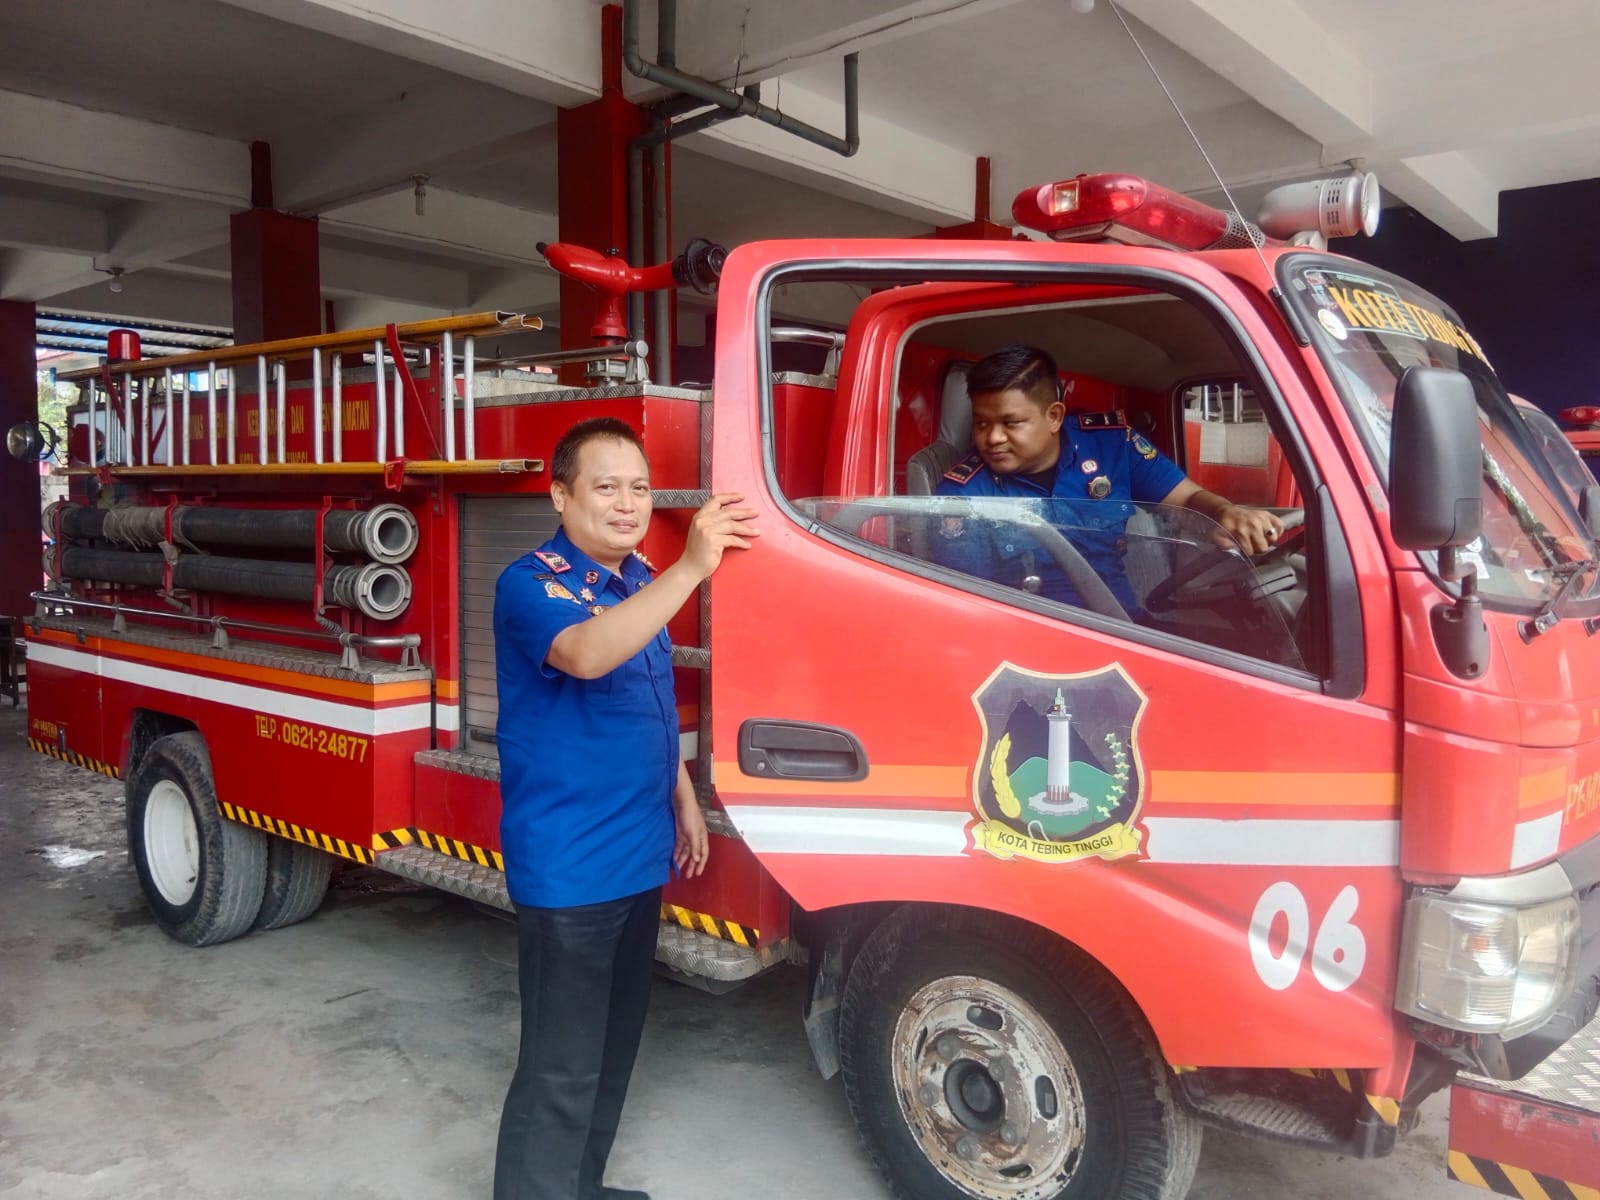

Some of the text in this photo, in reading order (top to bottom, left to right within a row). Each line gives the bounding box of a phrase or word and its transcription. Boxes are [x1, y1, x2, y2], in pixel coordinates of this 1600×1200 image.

[1327, 286, 1416, 334] KOTA
[290, 405, 304, 434] DAN
[282, 721, 368, 763] 0621-24877
[997, 831, 1113, 855] KOTA TEBING TINGGI
[1248, 881, 1367, 992] 06
